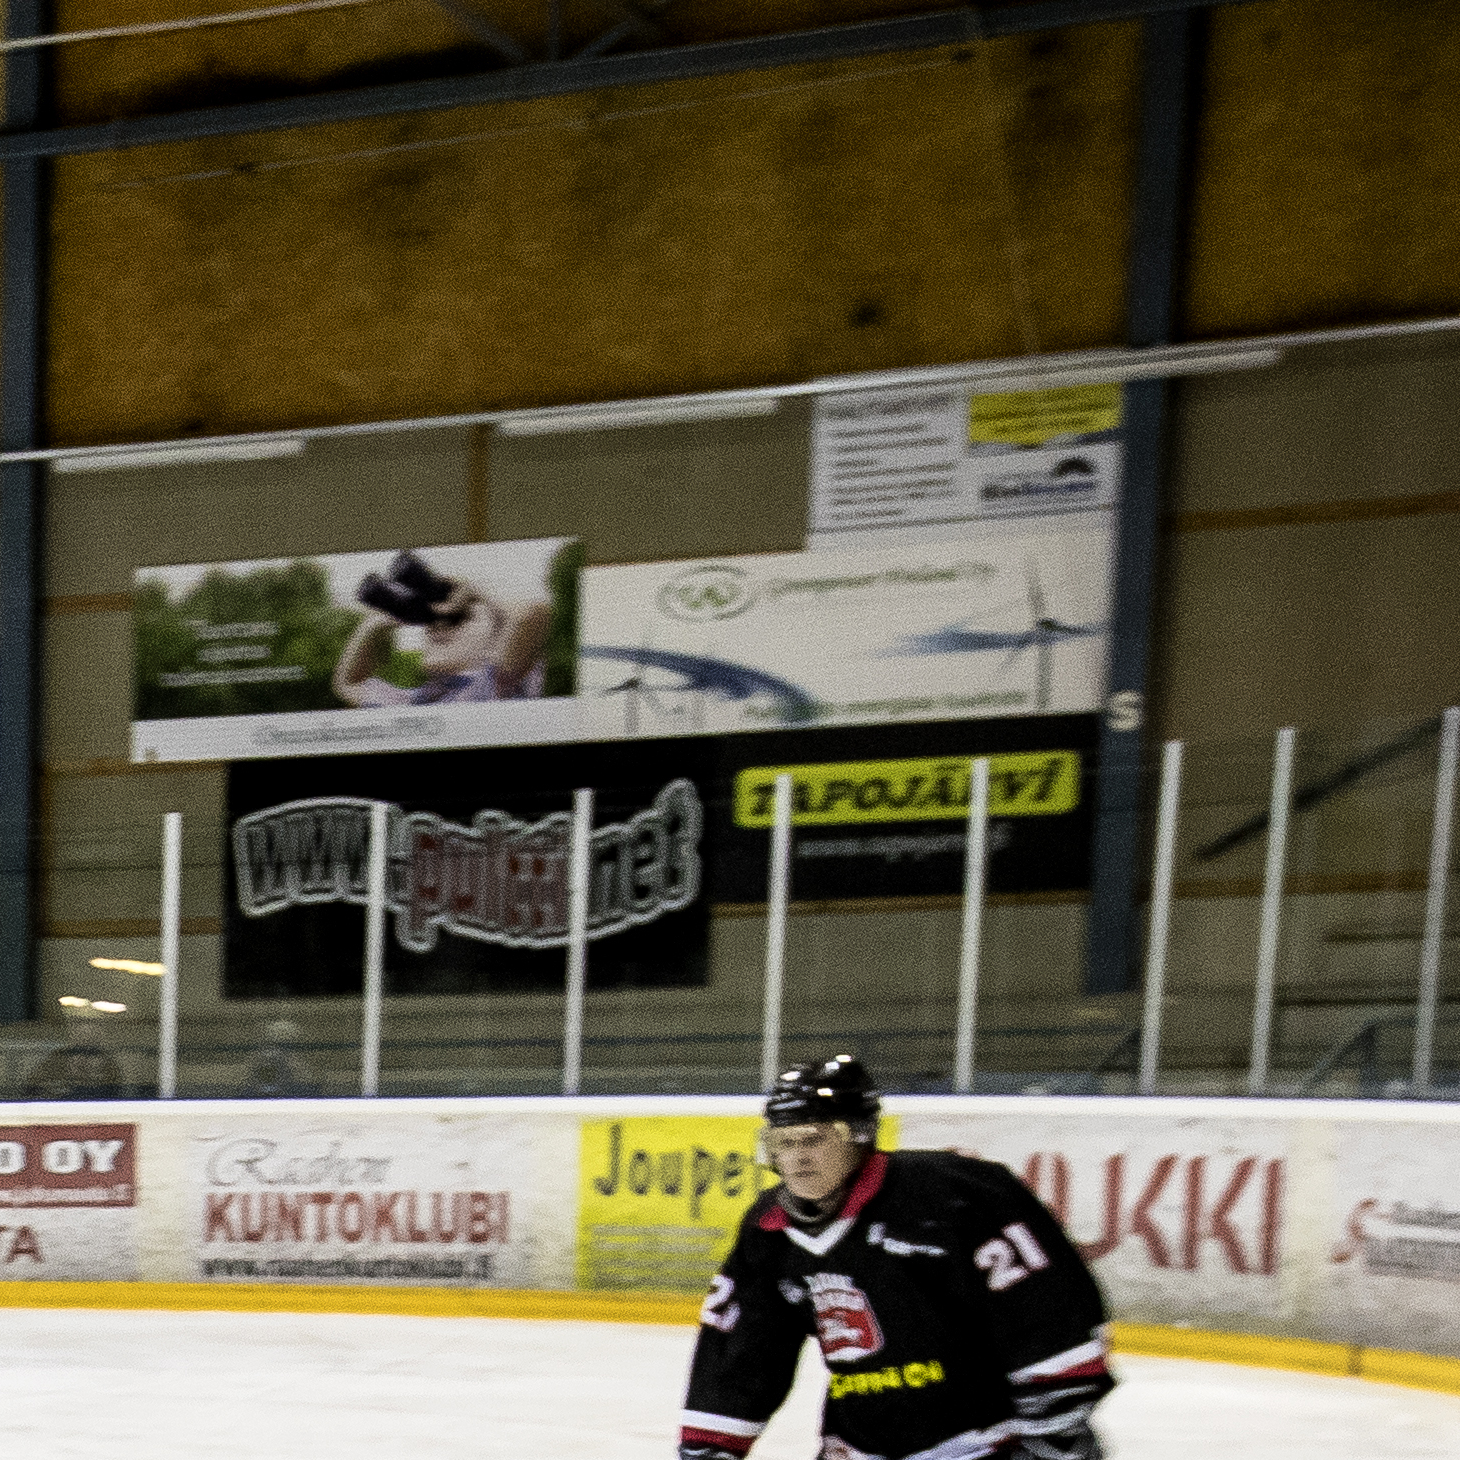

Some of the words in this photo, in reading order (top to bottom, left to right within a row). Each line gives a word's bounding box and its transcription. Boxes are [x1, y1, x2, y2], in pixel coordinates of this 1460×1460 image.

[749, 758, 1066, 818] TAPOJÄVI
[41, 1140, 126, 1174] OY
[205, 1190, 510, 1244] KUNTOKLUBI
[973, 1221, 1051, 1291] 21
